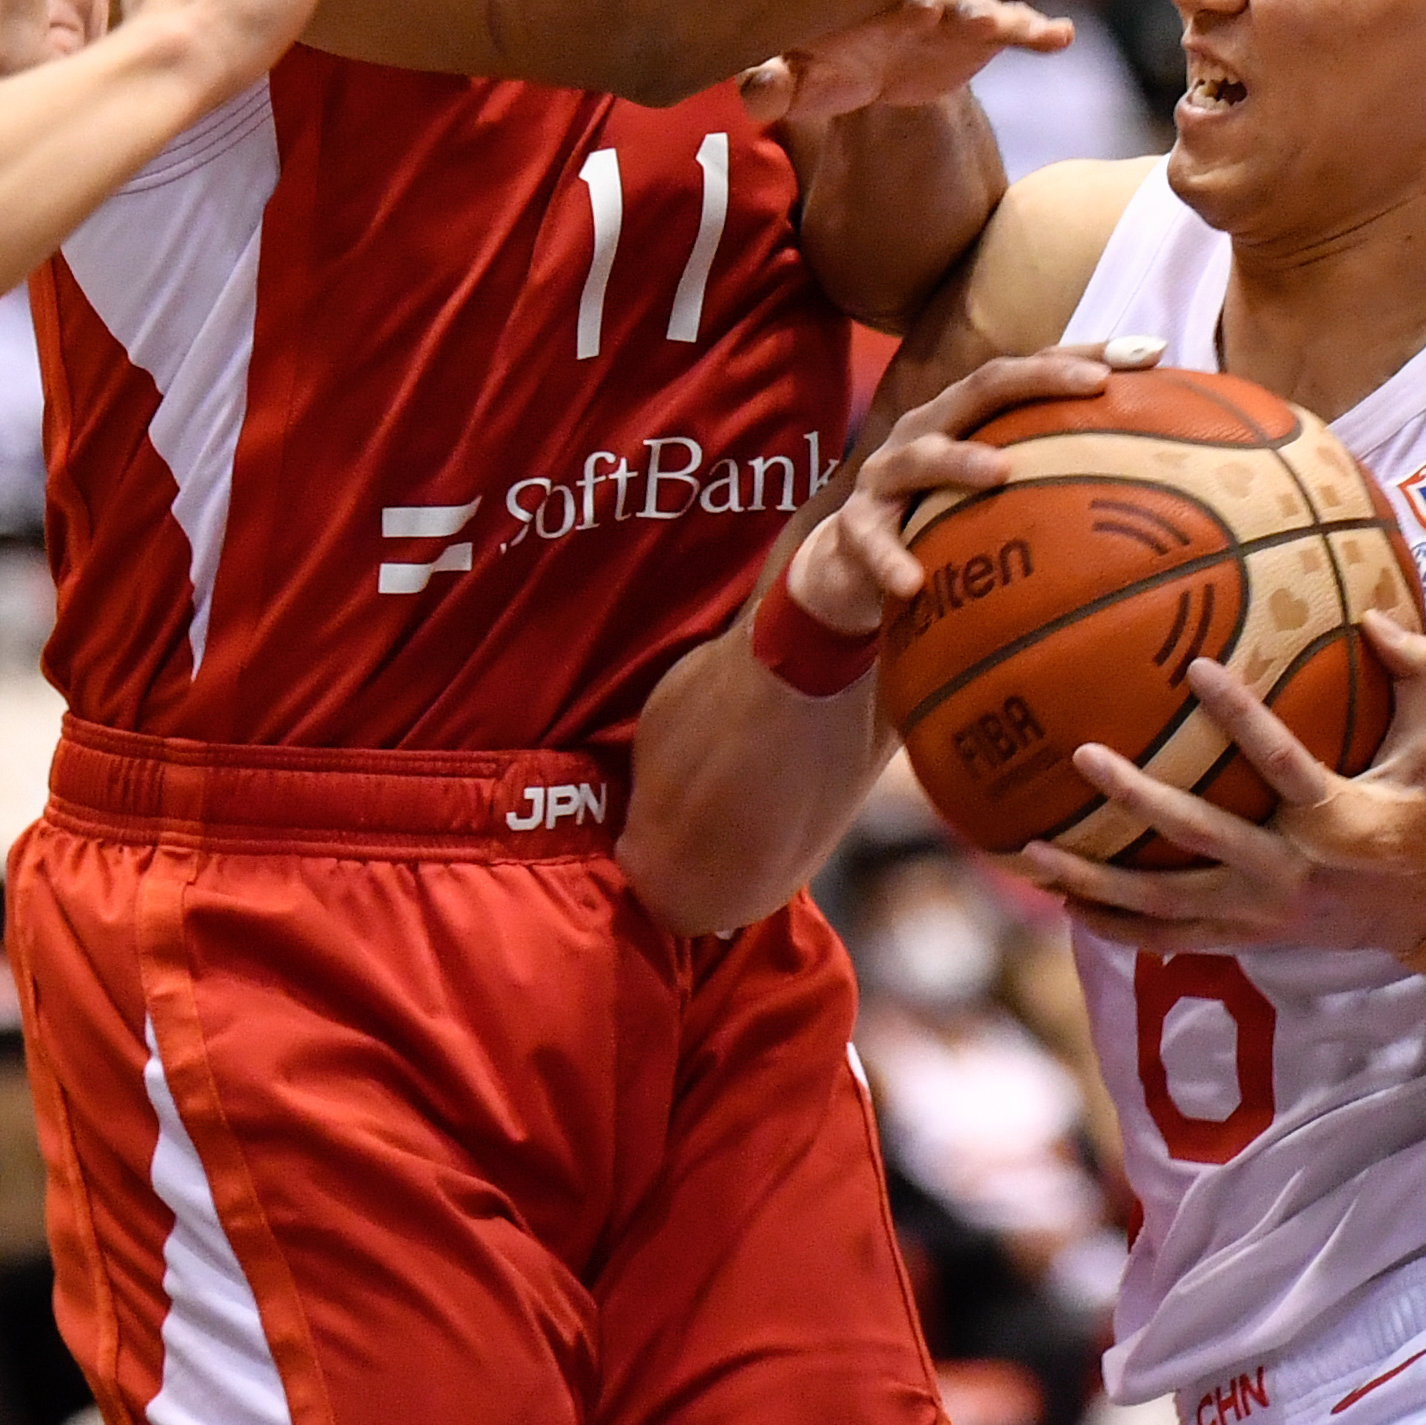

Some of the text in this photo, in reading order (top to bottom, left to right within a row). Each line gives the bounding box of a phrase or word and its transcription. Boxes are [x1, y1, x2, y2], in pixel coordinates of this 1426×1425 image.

[577, 132, 729, 360] 11
[500, 431, 840, 554] SoftBank
[893, 538, 1034, 646] olten
[505, 782, 607, 831] JPN
[1197, 1365, 1270, 1425] CHN
